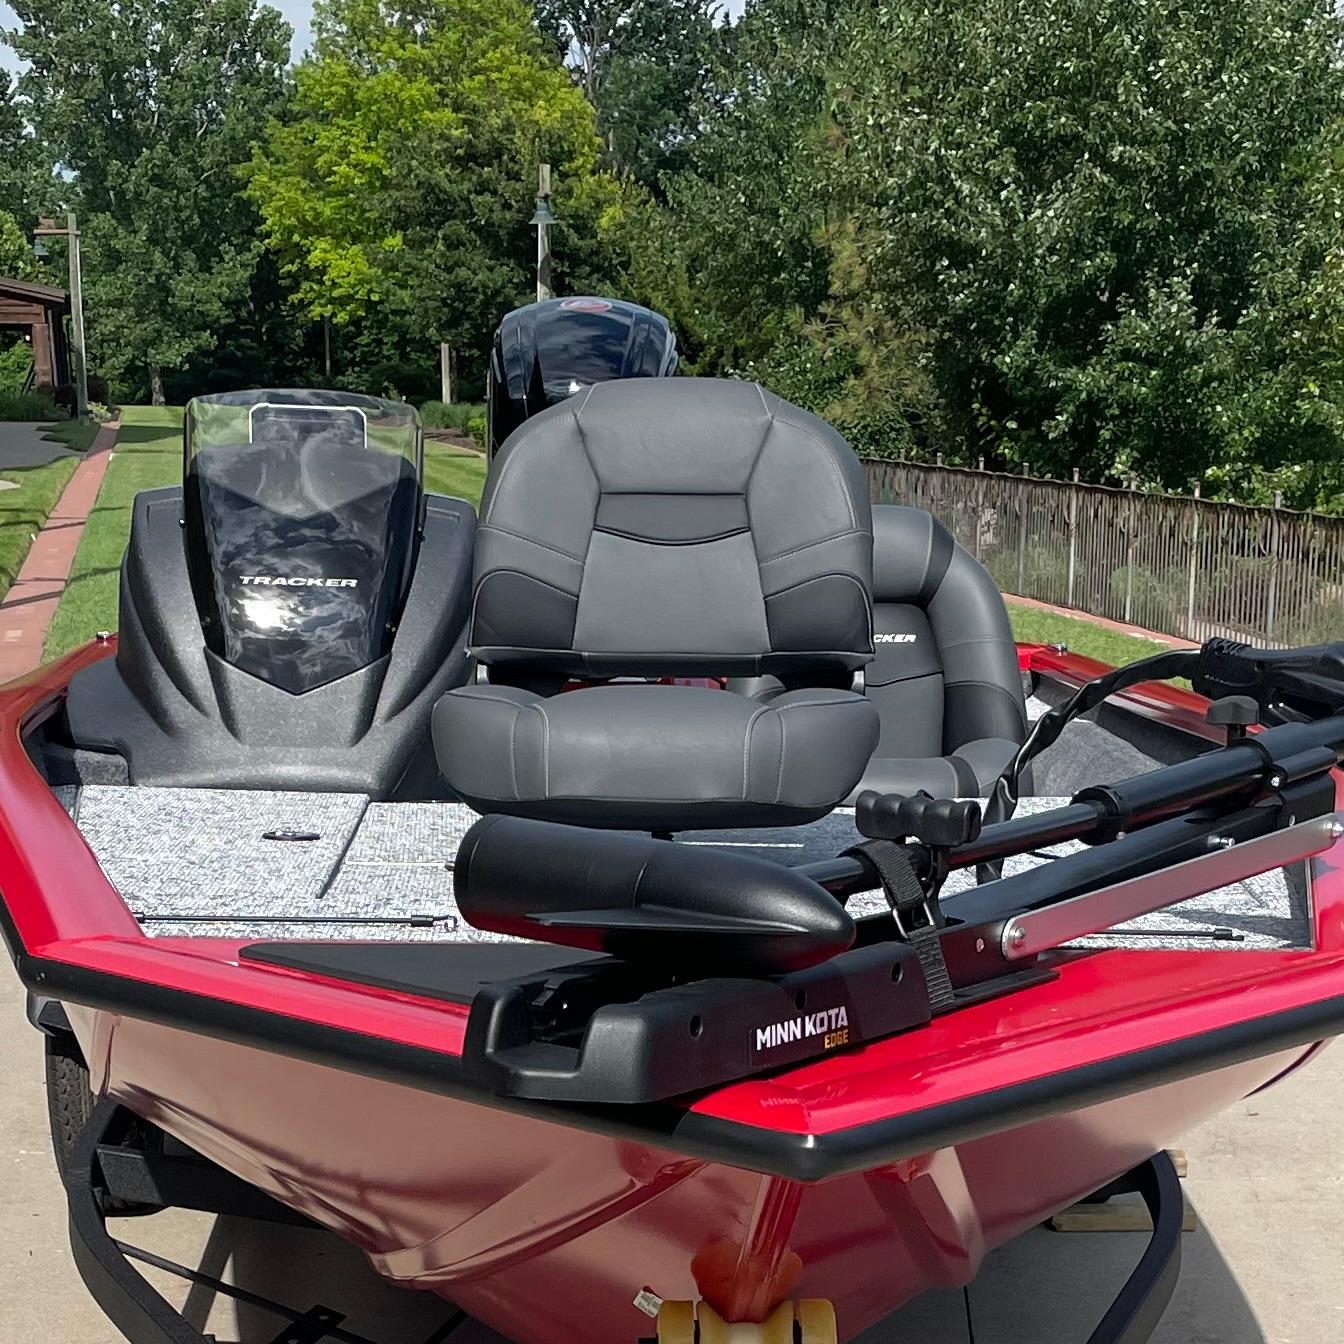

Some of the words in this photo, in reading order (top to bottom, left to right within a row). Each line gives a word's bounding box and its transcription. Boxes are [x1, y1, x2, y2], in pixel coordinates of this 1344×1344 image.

[239, 575, 358, 588] TRACKER
[756, 1017, 802, 1051] MINN
[804, 1005, 849, 1038] KOTA
[824, 1029, 849, 1049] EDGE
